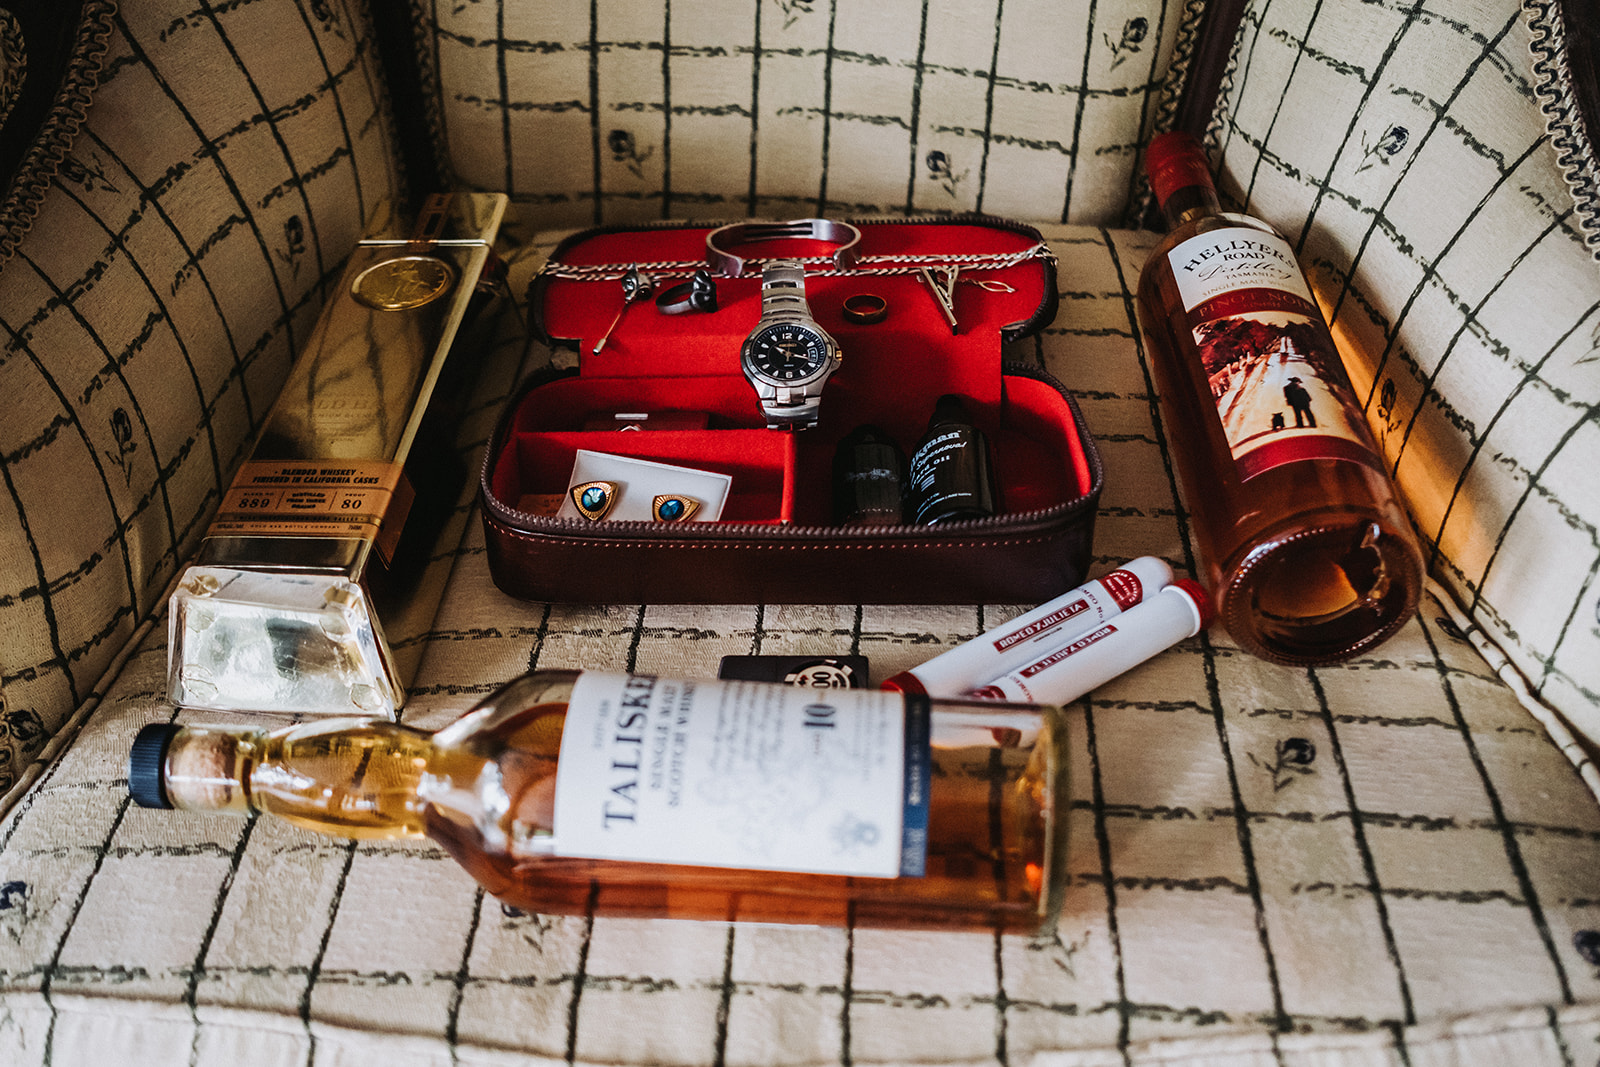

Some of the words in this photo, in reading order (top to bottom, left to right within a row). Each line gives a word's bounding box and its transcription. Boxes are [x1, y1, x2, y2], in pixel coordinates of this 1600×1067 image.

[1183, 240, 1295, 272] HELLYERS
[1223, 252, 1265, 261] ROAD
[1198, 261, 1292, 282] Distillery
[1225, 271, 1276, 280] TASMANIA
[1202, 281, 1235, 297] SINGLE
[1200, 292, 1256, 317] PINOT
[785, 371, 793, 379] 6
[239, 498, 270, 508] 889
[341, 499, 362, 509] 80
[999, 626, 1034, 648] ROMEO
[1033, 621, 1042, 632] Y
[1040, 602, 1084, 630] JULIETA
[1077, 626, 1112, 648] ROMEO
[1029, 648, 1071, 673] JULIETA
[804, 704, 836, 728] 10
[603, 674, 658, 832] TALISKE
[669, 732, 687, 807] SCOTCH
